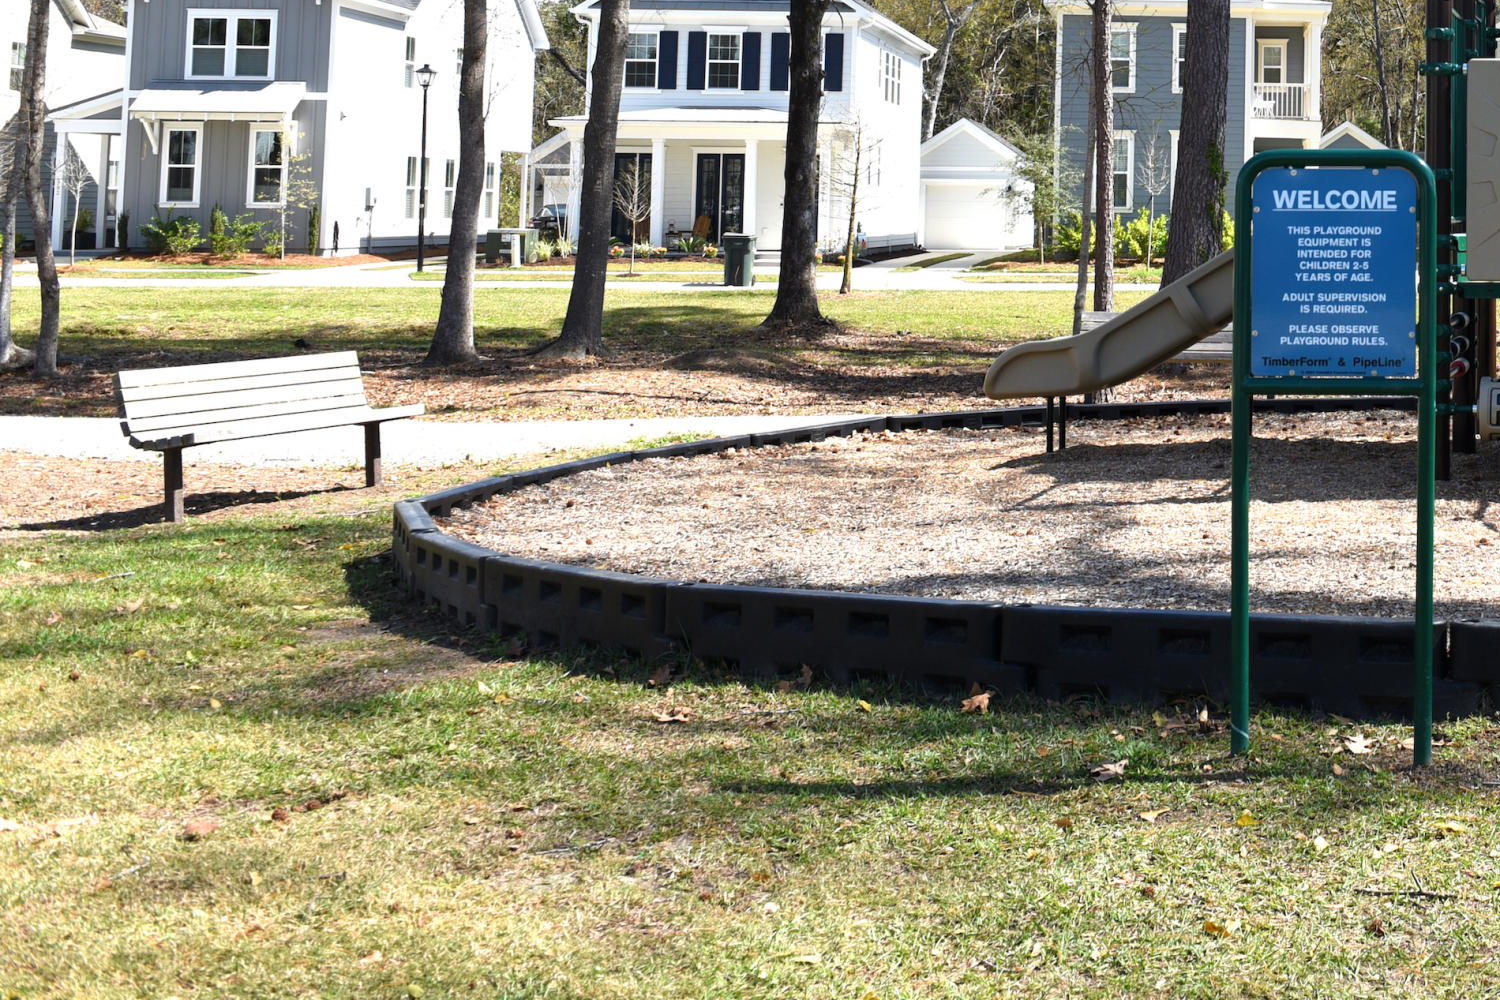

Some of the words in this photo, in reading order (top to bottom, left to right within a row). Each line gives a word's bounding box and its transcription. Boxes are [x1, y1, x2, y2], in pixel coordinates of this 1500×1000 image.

[1272, 190, 1398, 210] WELCOME
[1287, 226, 1311, 236] THIS
[1313, 226, 1382, 236] PLAYGROUND
[1298, 238, 1359, 247] EQUIPMENT
[1361, 238, 1372, 247] IS
[1297, 250, 1348, 259] INTENDED
[1350, 250, 1372, 259] FOR
[1299, 261, 1350, 270] CHILDREN
[1352, 261, 1369, 270] 2-5
[1295, 273, 1331, 282] YEARS
[1333, 273, 1348, 282] OF
[1350, 273, 1374, 282] AGE.
[1282, 293, 1315, 302] ADULT
[1317, 293, 1387, 302] SUPERVISION
[1300, 305, 1311, 314] IS
[1313, 305, 1368, 314] REQUIRED.
[1288, 325, 1329, 334] PLEASE
[1331, 325, 1379, 334] OBSERVE
[1280, 337, 1349, 346] PLAYGROUND
[1351, 337, 1389, 346] RULES.
[1337, 358, 1346, 367] &
